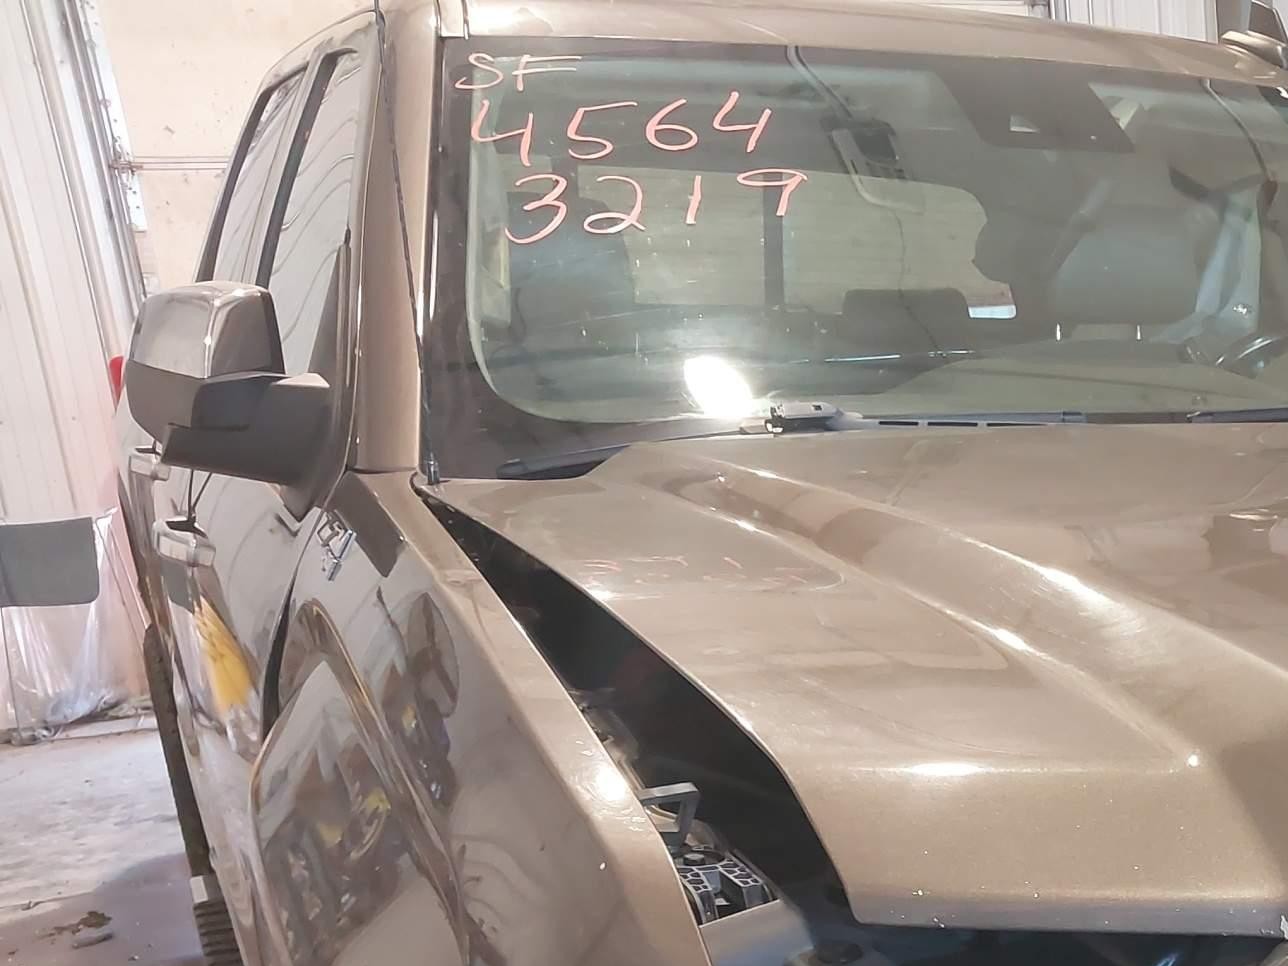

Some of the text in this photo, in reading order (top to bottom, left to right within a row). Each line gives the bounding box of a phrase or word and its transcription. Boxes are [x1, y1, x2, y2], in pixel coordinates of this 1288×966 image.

[454, 53, 582, 91] SF
[471, 92, 771, 167] 4564
[504, 168, 807, 244] 3219
